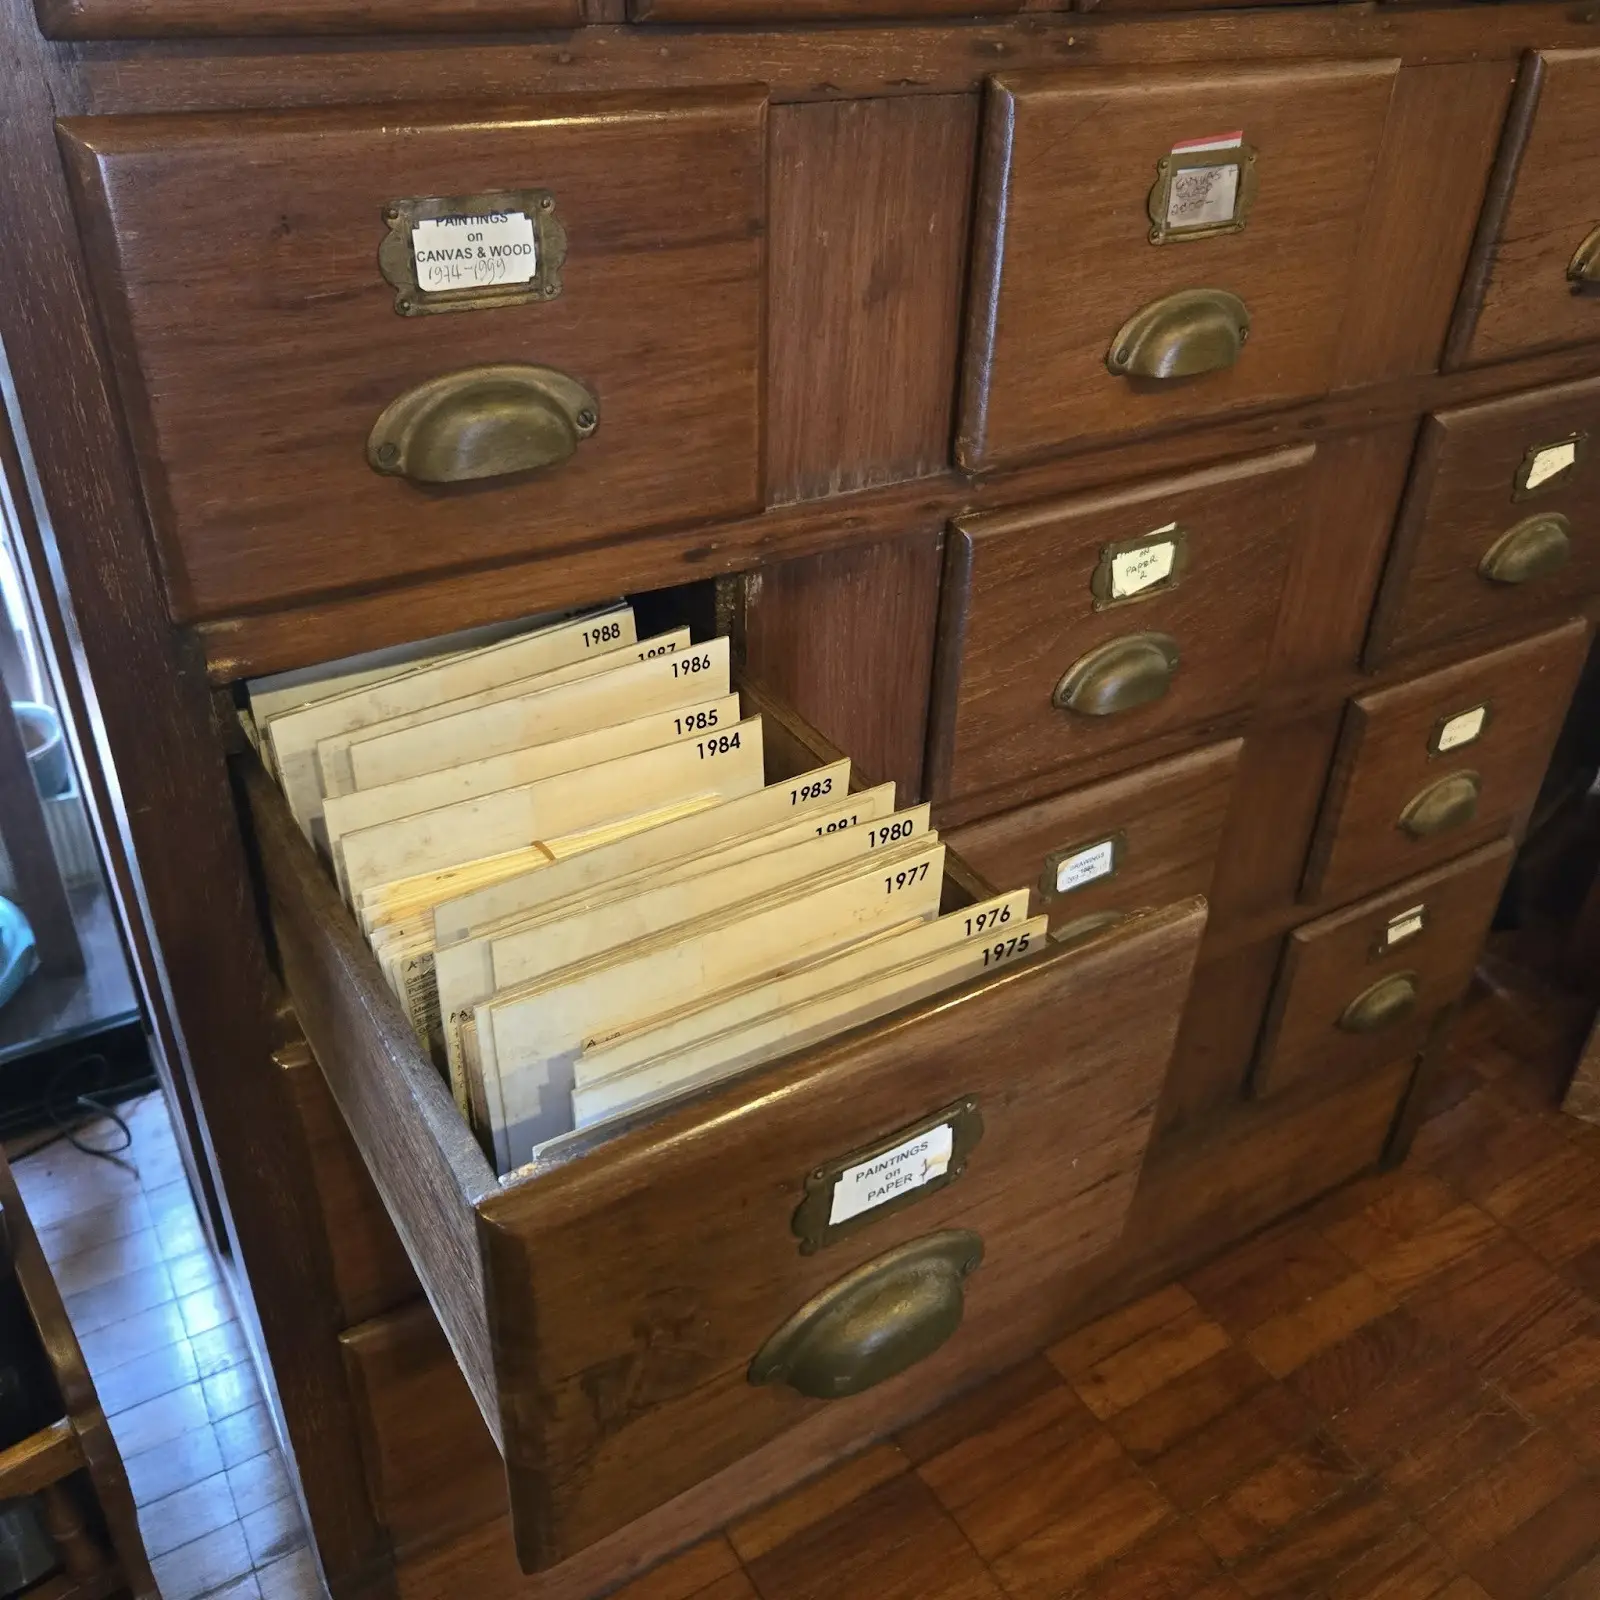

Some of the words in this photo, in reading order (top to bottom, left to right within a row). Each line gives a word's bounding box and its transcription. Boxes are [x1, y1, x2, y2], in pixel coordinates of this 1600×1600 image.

[467, 231, 483, 242] on
[417, 247, 473, 262] CANVAS
[477, 247, 486, 258] &
[489, 243, 532, 257] WOOD
[582, 622, 621, 648] 1988
[671, 654, 711, 678] 1986
[674, 709, 718, 735] 1985
[697, 732, 741, 760] 1984
[790, 778, 833, 806] 1983
[868, 819, 913, 848] 1980
[884, 861, 930, 894] 1977
[964, 904, 1011, 936] 1976
[982, 932, 1030, 967] 1975
[855, 1140, 929, 1183] PAINTINGS
[885, 1167, 901, 1180] on
[867, 1172, 914, 1202] PAPER
